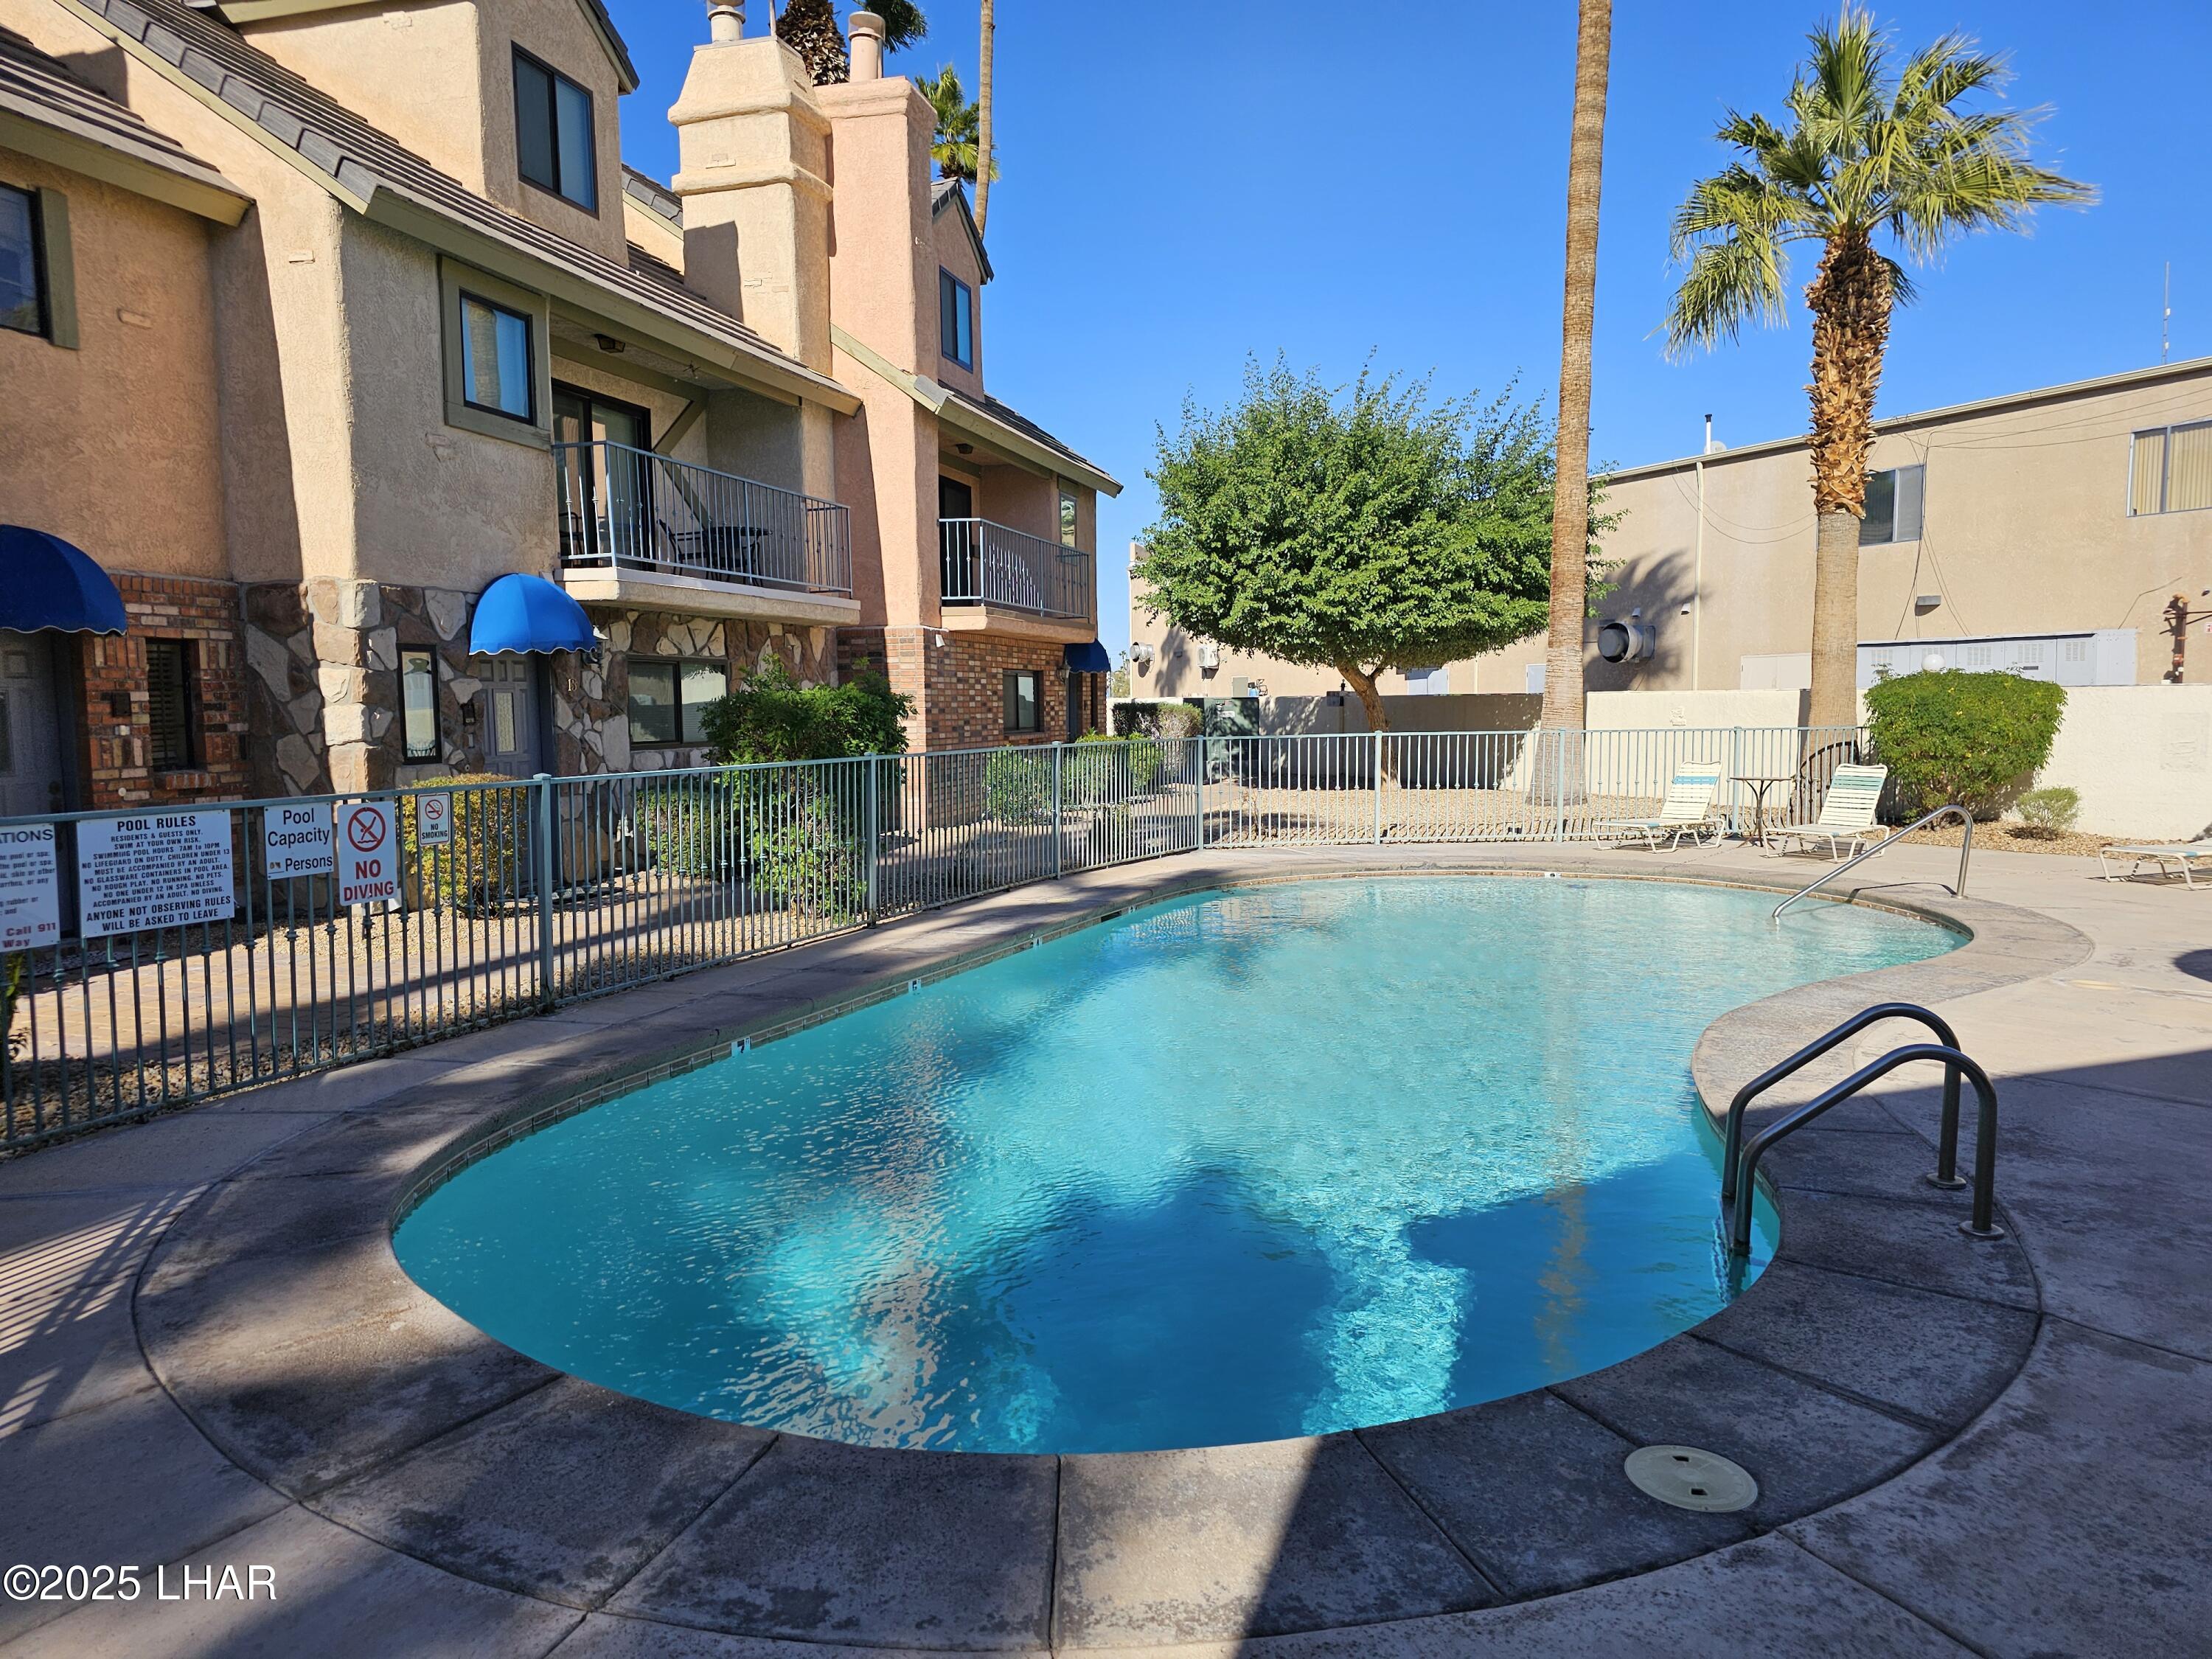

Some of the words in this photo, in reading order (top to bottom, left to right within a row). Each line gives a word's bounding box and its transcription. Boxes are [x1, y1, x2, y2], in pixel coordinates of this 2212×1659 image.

[117, 819, 150, 832] POOL
[156, 815, 195, 829] RULES
[282, 808, 315, 825] Pool
[421, 830, 448, 839] SMOKING
[431, 823, 439, 831] NO
[111, 833, 147, 842] RESIDENTS
[159, 830, 183, 838] GUESTS
[268, 827, 330, 848] Capacity
[93, 850, 131, 860] SWIMMING
[94, 858, 131, 868] LIFEGUARD
[167, 852, 198, 860] CHILDREN
[128, 863, 175, 872] ACCOMPANIED
[285, 856, 333, 872] Persons
[355, 859, 381, 880] NO
[97, 873, 138, 883] GLASSWARE
[142, 869, 181, 879] CONTAINERS
[105, 883, 127, 891] ROUGH
[130, 880, 148, 888] PLAY.
[163, 874, 193, 883] RUNNING.
[190, 880, 215, 888] UNLESS
[93, 897, 142, 908] ACCOMPANIED
[202, 886, 224, 894] DIVING.
[344, 880, 394, 902] DIVING
[86, 908, 125, 922] ANYONE
[129, 905, 147, 917] NOT
[151, 900, 201, 914] OBSERVING
[205, 895, 231, 907] RULES
[102, 921, 125, 931] WILL
[129, 918, 140, 928] BE
[145, 914, 174, 926] ASKED
[178, 911, 189, 922] TO
[193, 908, 218, 919] LEAVE
[6, 925, 32, 936] Call
[38, 922, 56, 932] 911
[2, 939, 30, 948] Way
